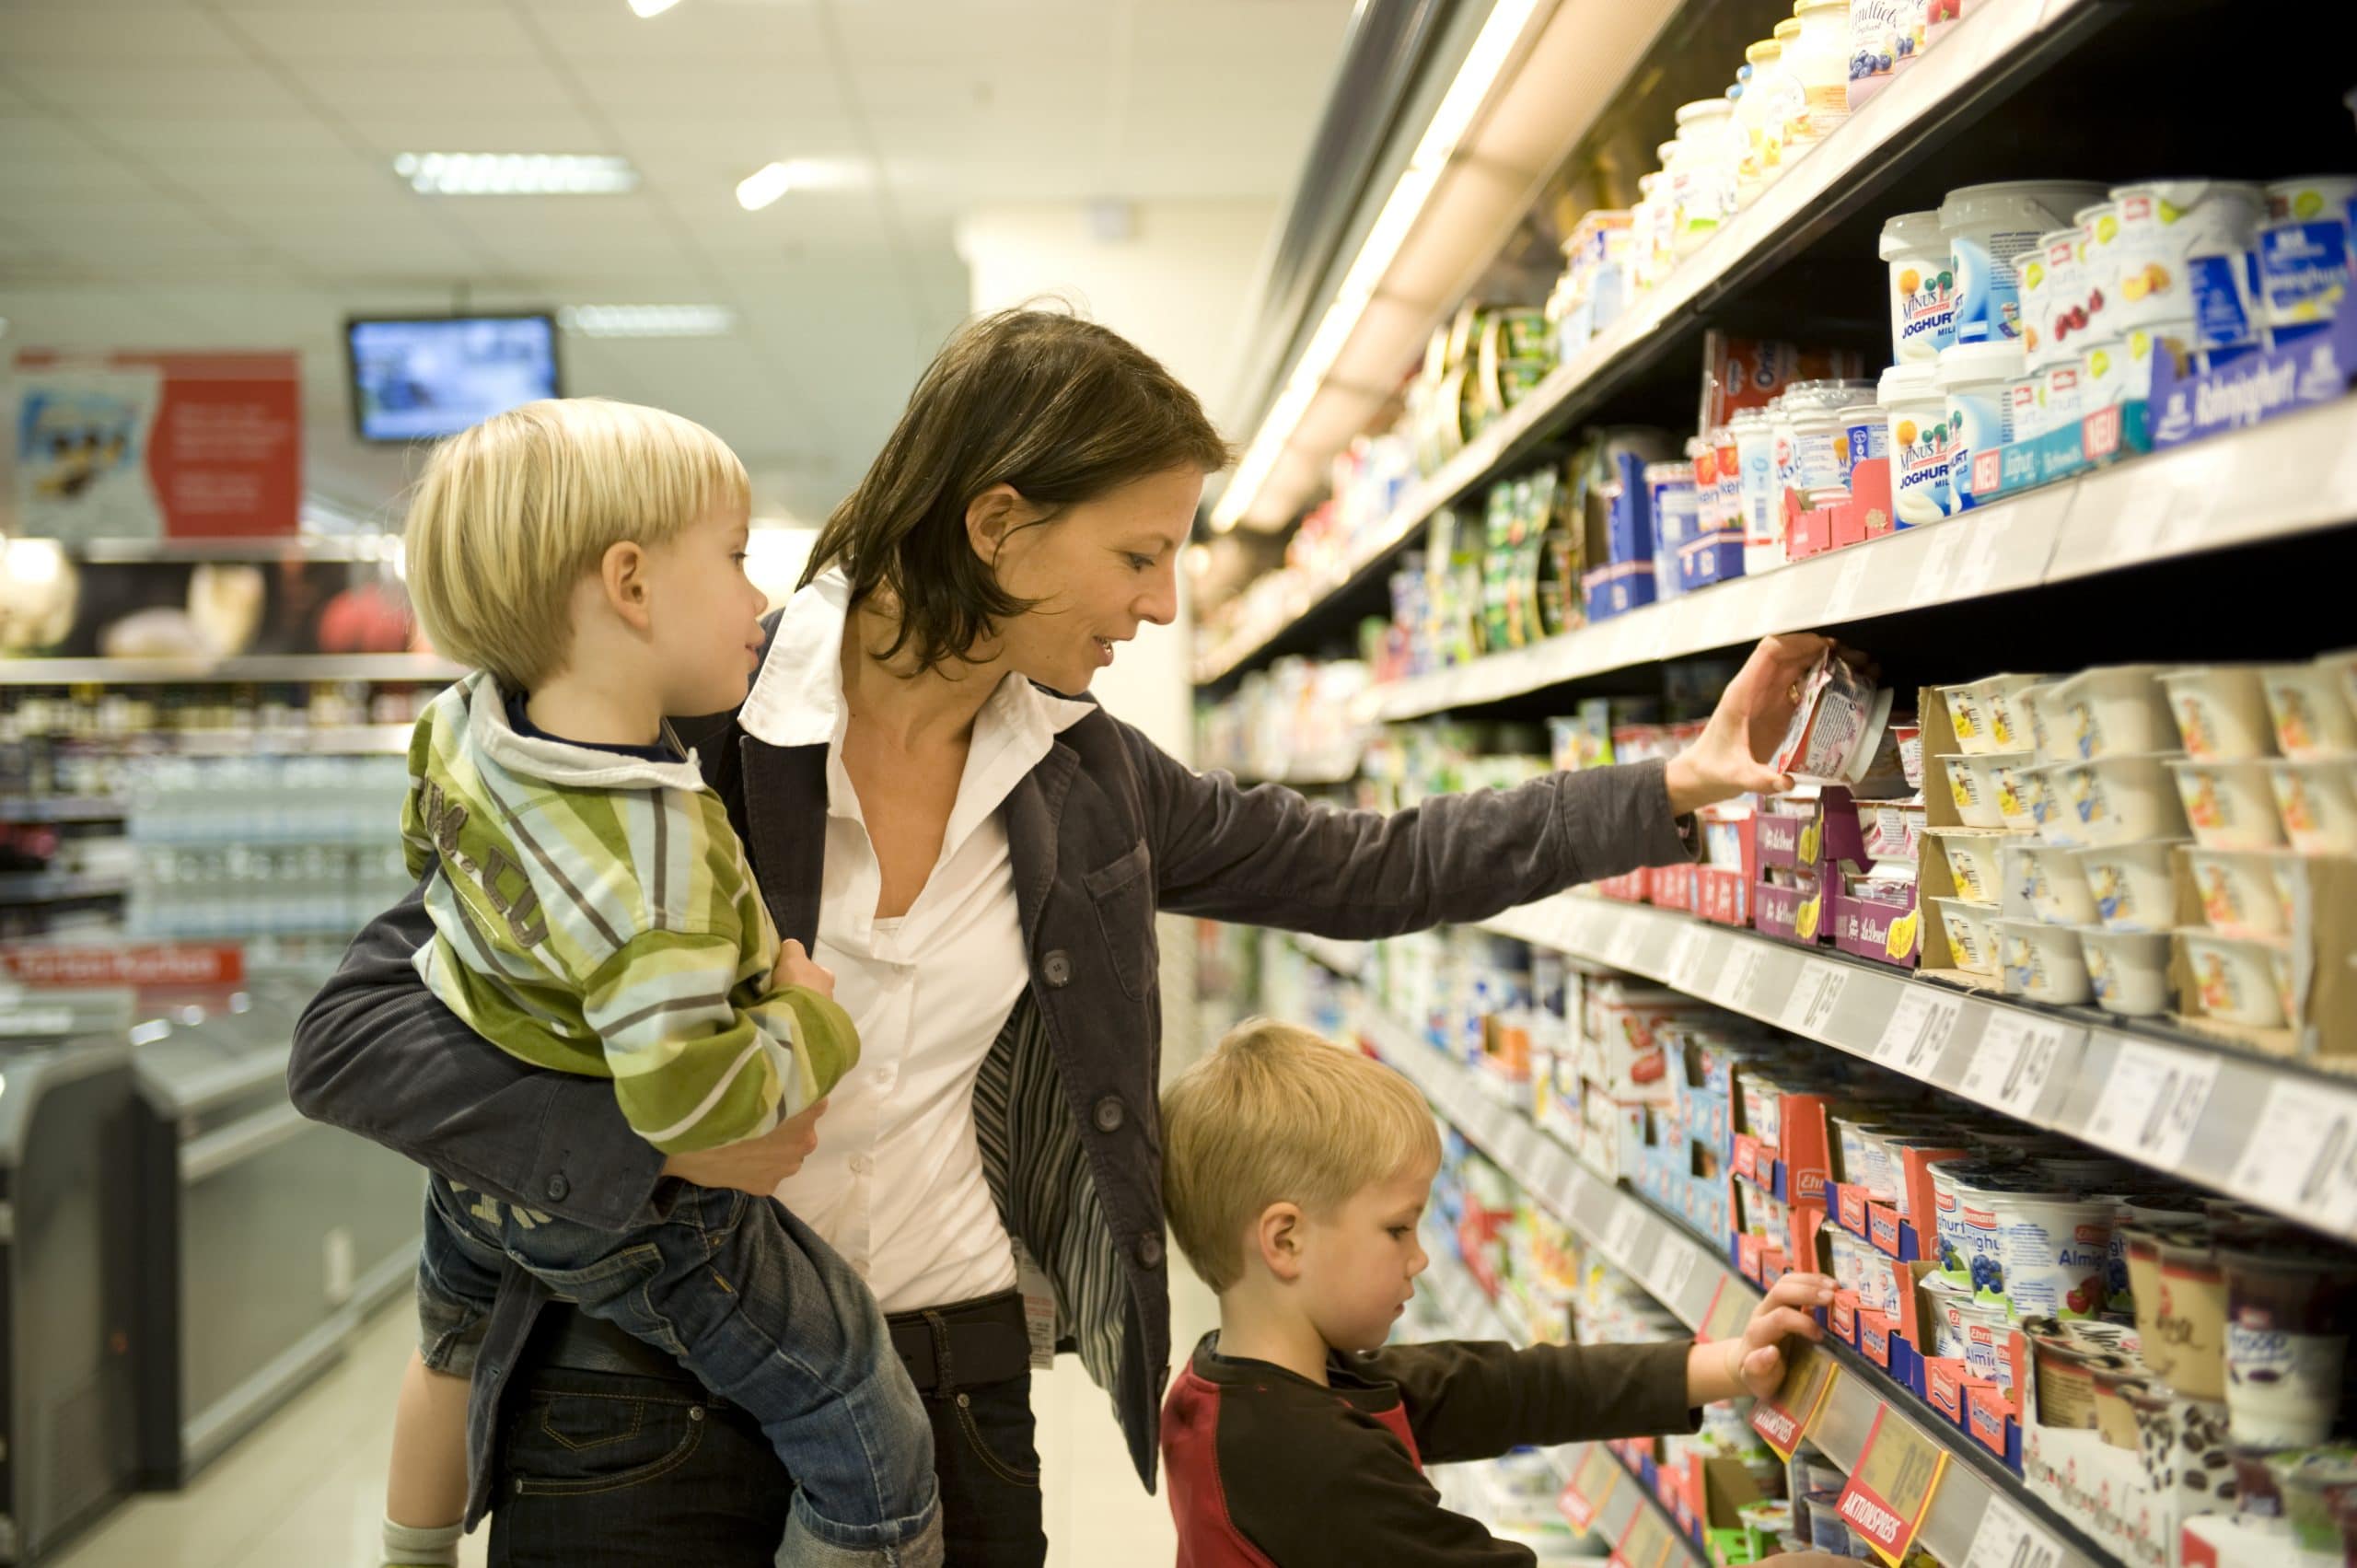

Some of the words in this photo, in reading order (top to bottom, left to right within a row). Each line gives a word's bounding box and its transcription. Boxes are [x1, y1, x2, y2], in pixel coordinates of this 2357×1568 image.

[1900, 463, 1949, 489] JOGHUR
[1973, 455, 1999, 488] NEU
[1841, 1491, 1901, 1545] AKTIONSPREIS
